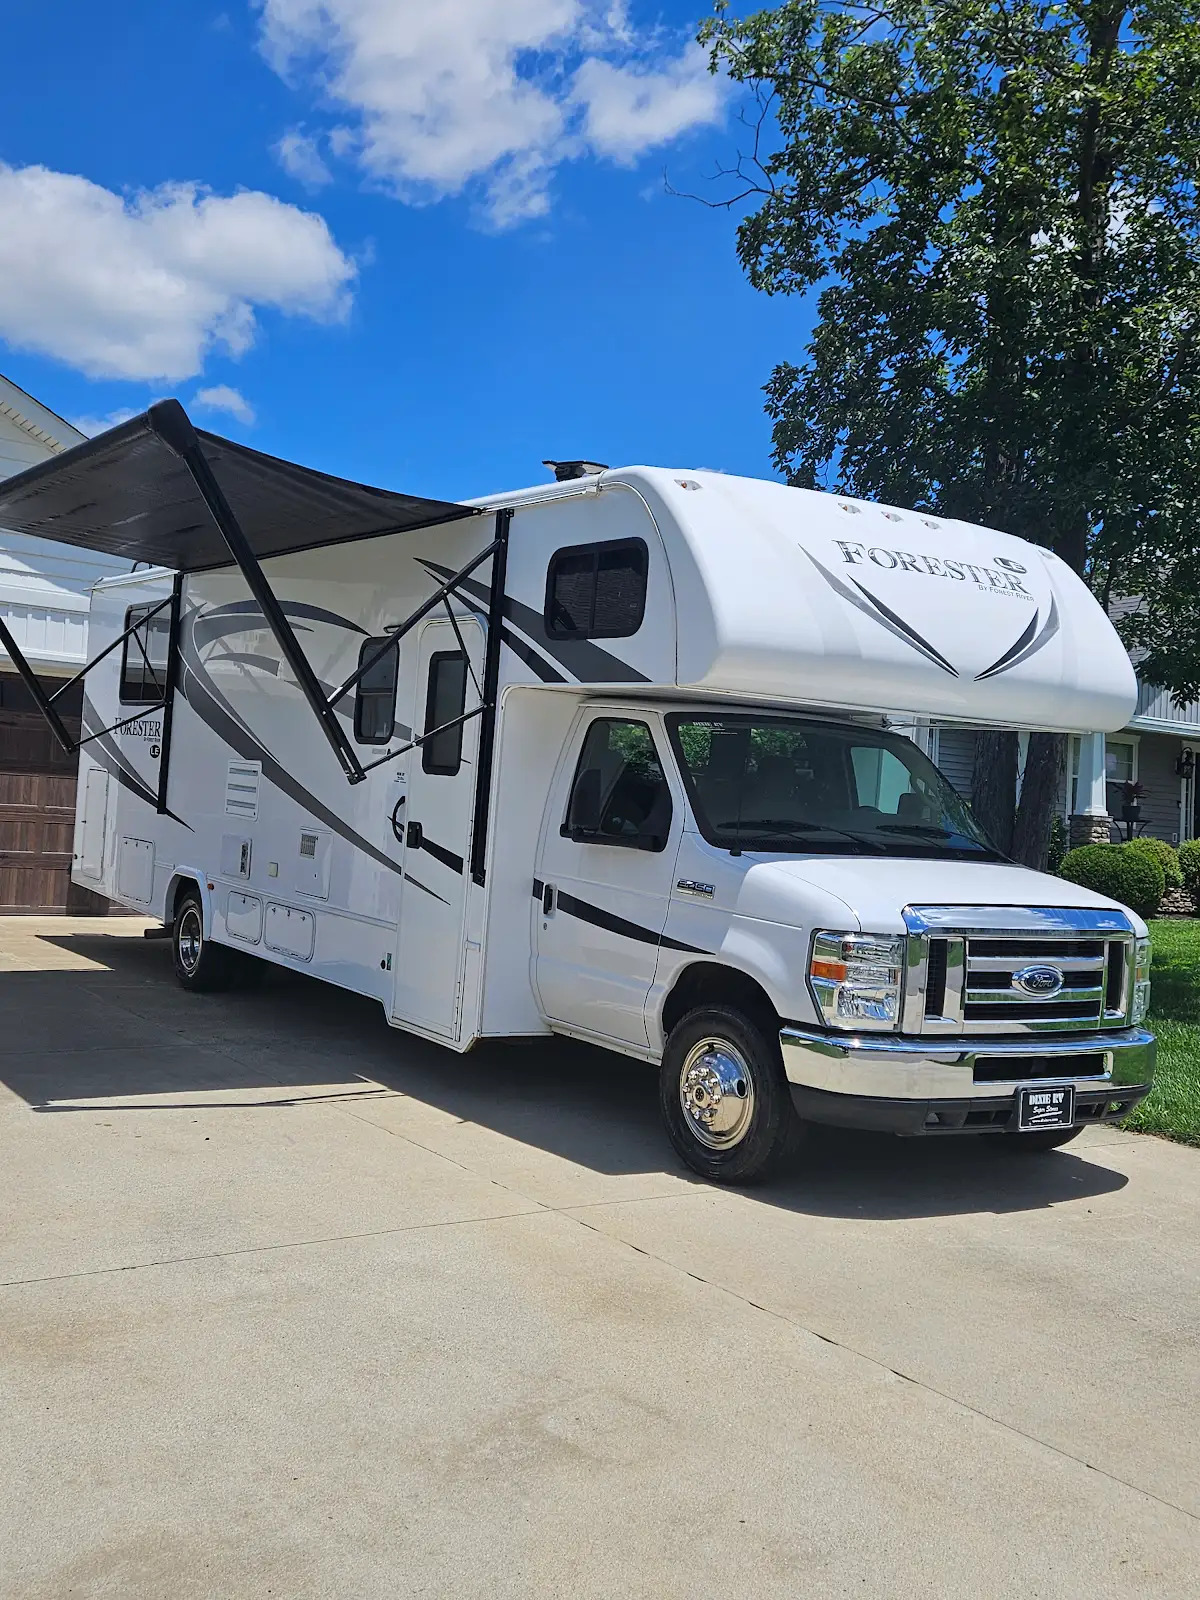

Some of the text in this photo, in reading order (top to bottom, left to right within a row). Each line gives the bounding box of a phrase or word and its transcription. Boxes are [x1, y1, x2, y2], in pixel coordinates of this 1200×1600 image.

[831, 539, 1032, 595] FORESTER
[989, 586, 1015, 597] FOREST
[1015, 592, 1035, 602] RIVER
[113, 717, 161, 737] FORESTER
[150, 746, 160, 756] LE
[1032, 973, 1056, 988] Ford
[1028, 1092, 1065, 1106] DIXIE RV
